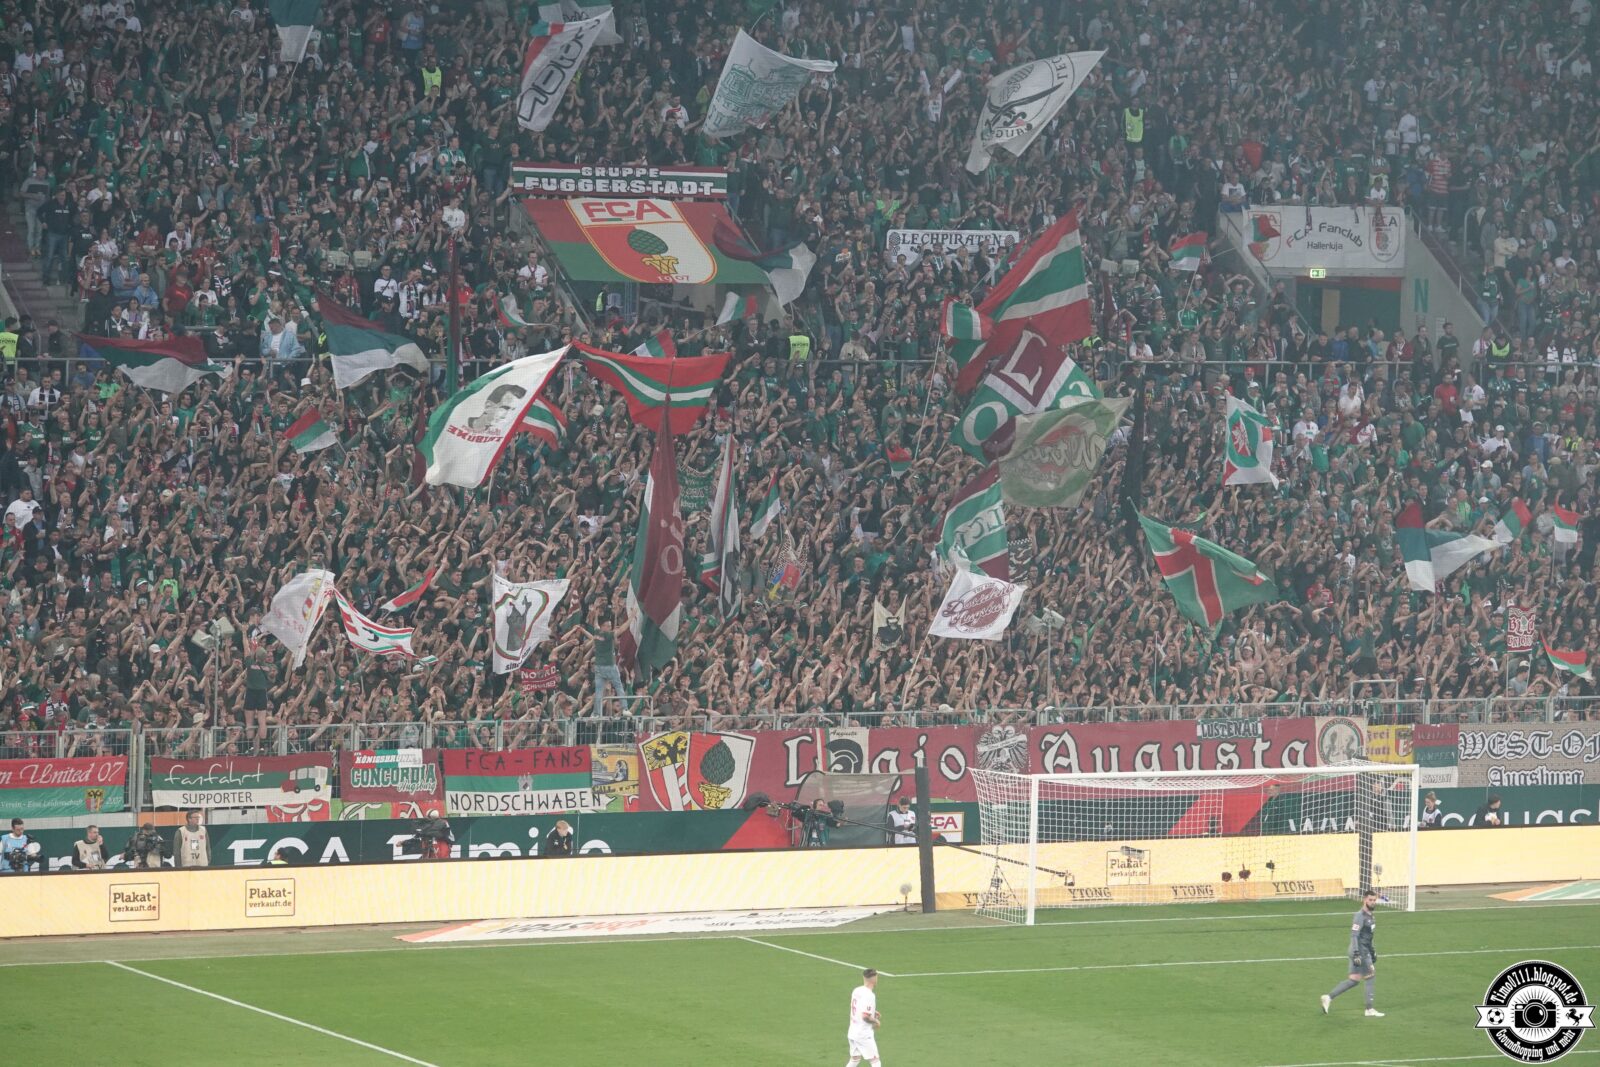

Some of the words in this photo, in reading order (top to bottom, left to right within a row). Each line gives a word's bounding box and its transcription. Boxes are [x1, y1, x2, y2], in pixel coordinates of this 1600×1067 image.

[581, 166, 660, 178] GRUPPE
[524, 176, 714, 195] FUGGERSTADT
[582, 200, 672, 220] FCA
[901, 232, 1002, 246] LECHPIRATEN
[1318, 222, 1363, 248] Fanclub
[1201, 720, 1259, 738] LUSTENAU
[465, 752, 506, 771] FCA
[533, 749, 583, 769] FANS
[19, 762, 95, 785] United
[97, 761, 124, 783] 07
[351, 763, 436, 787] CONCORDIA
[182, 792, 253, 805] SUPPORTER
[450, 791, 601, 812] NORDSCHWABEN
[1068, 886, 1112, 899] YTONG
[1171, 884, 1215, 897] YTONG
[1272, 880, 1316, 893] YTONG
[112, 892, 157, 904] Plakat-
[249, 888, 292, 899] Plakat-
[112, 904, 157, 913] verkauft.de
[249, 899, 292, 908] verkauft.de
